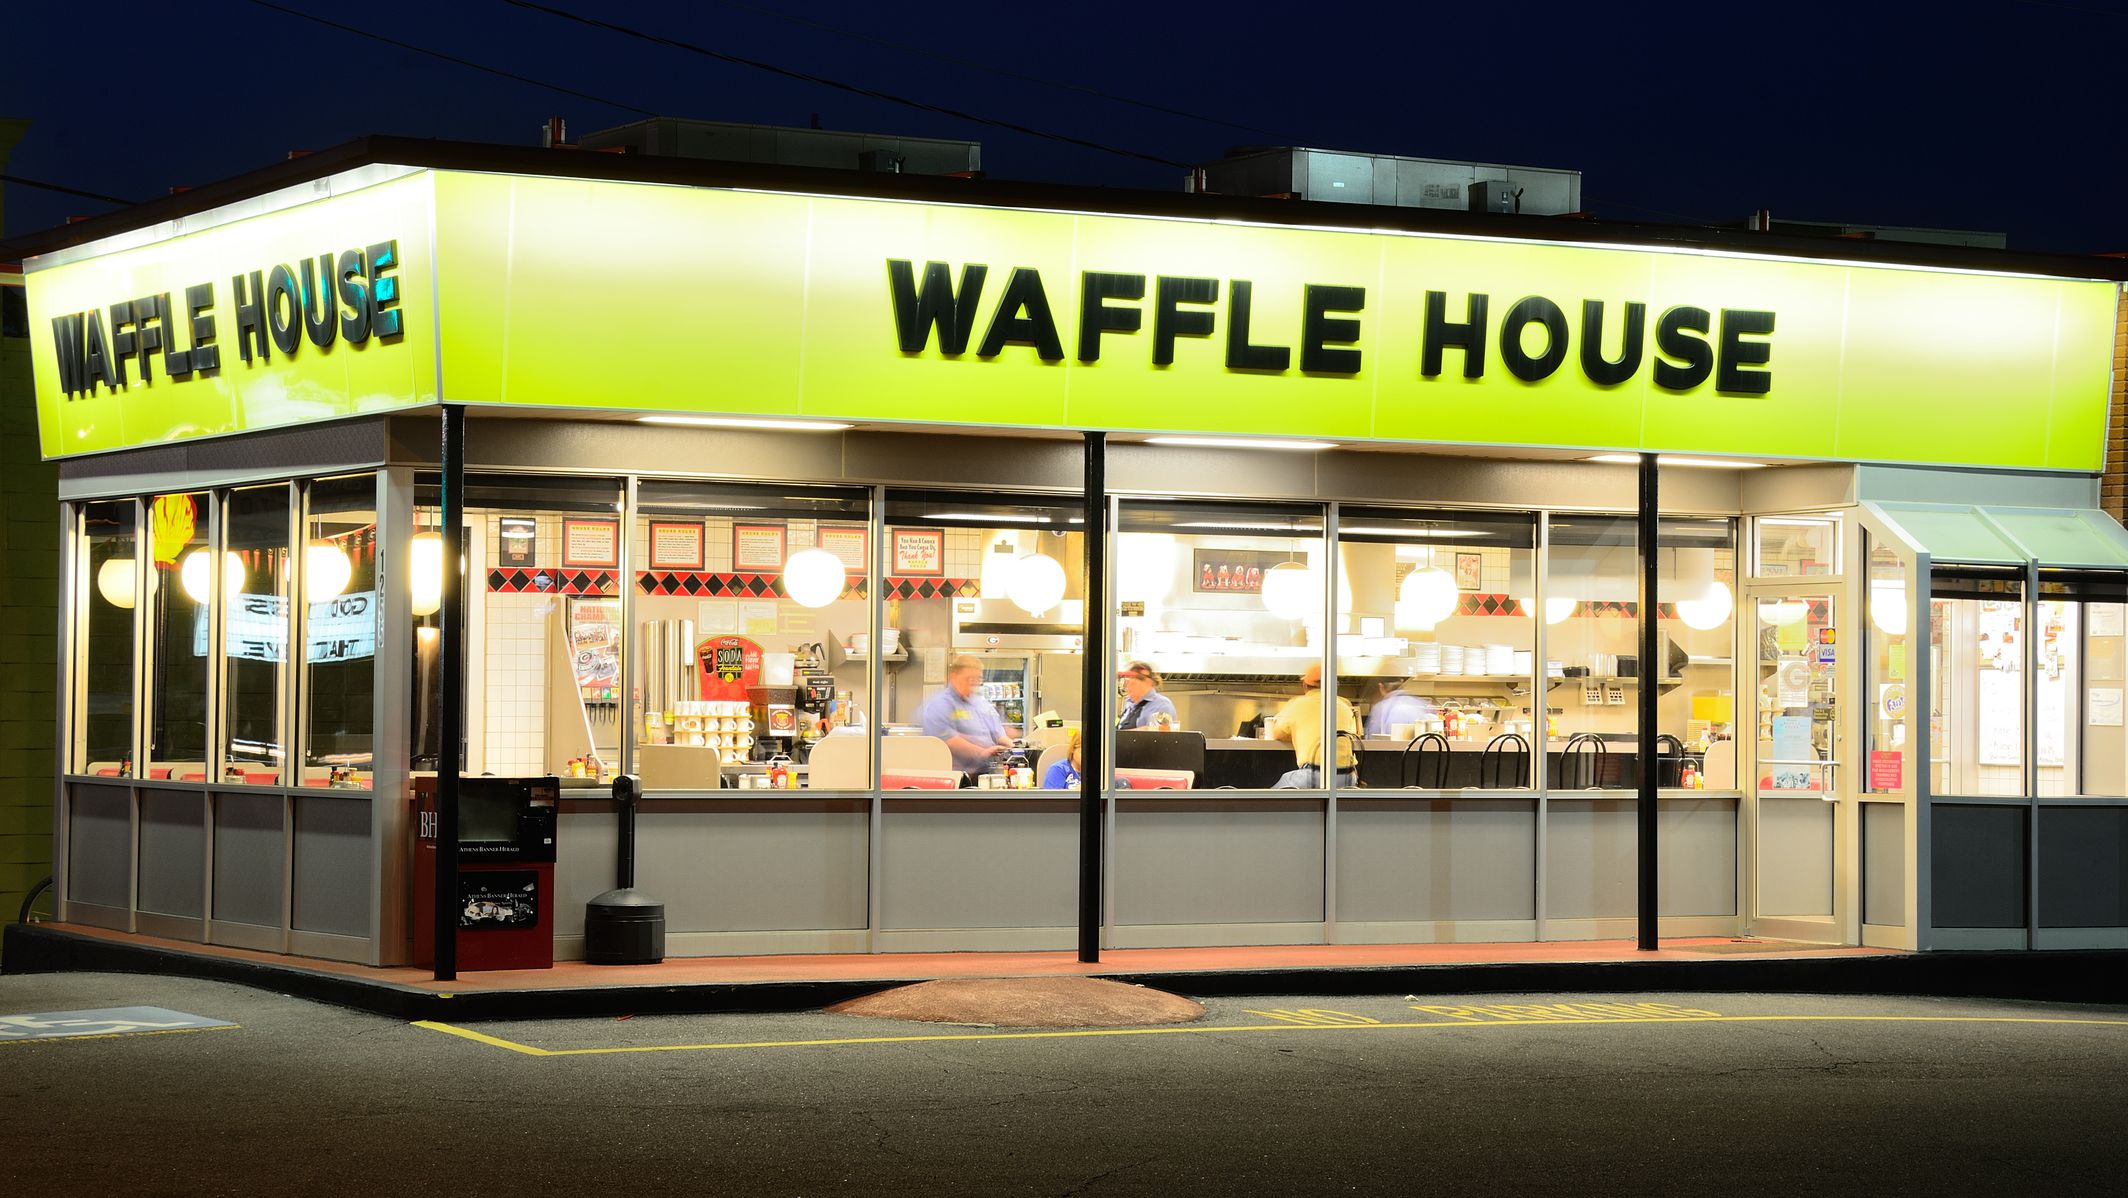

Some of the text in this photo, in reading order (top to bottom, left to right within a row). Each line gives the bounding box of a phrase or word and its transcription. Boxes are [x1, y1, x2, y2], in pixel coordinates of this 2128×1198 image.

[51, 240, 404, 400] WAFFLE HOUSE
[887, 258, 1776, 393] WAFFLE HOUSE
[718, 650, 742, 662] SODA
[1822, 648, 1834, 656] VISA
[1241, 1009, 1381, 1024] NO
